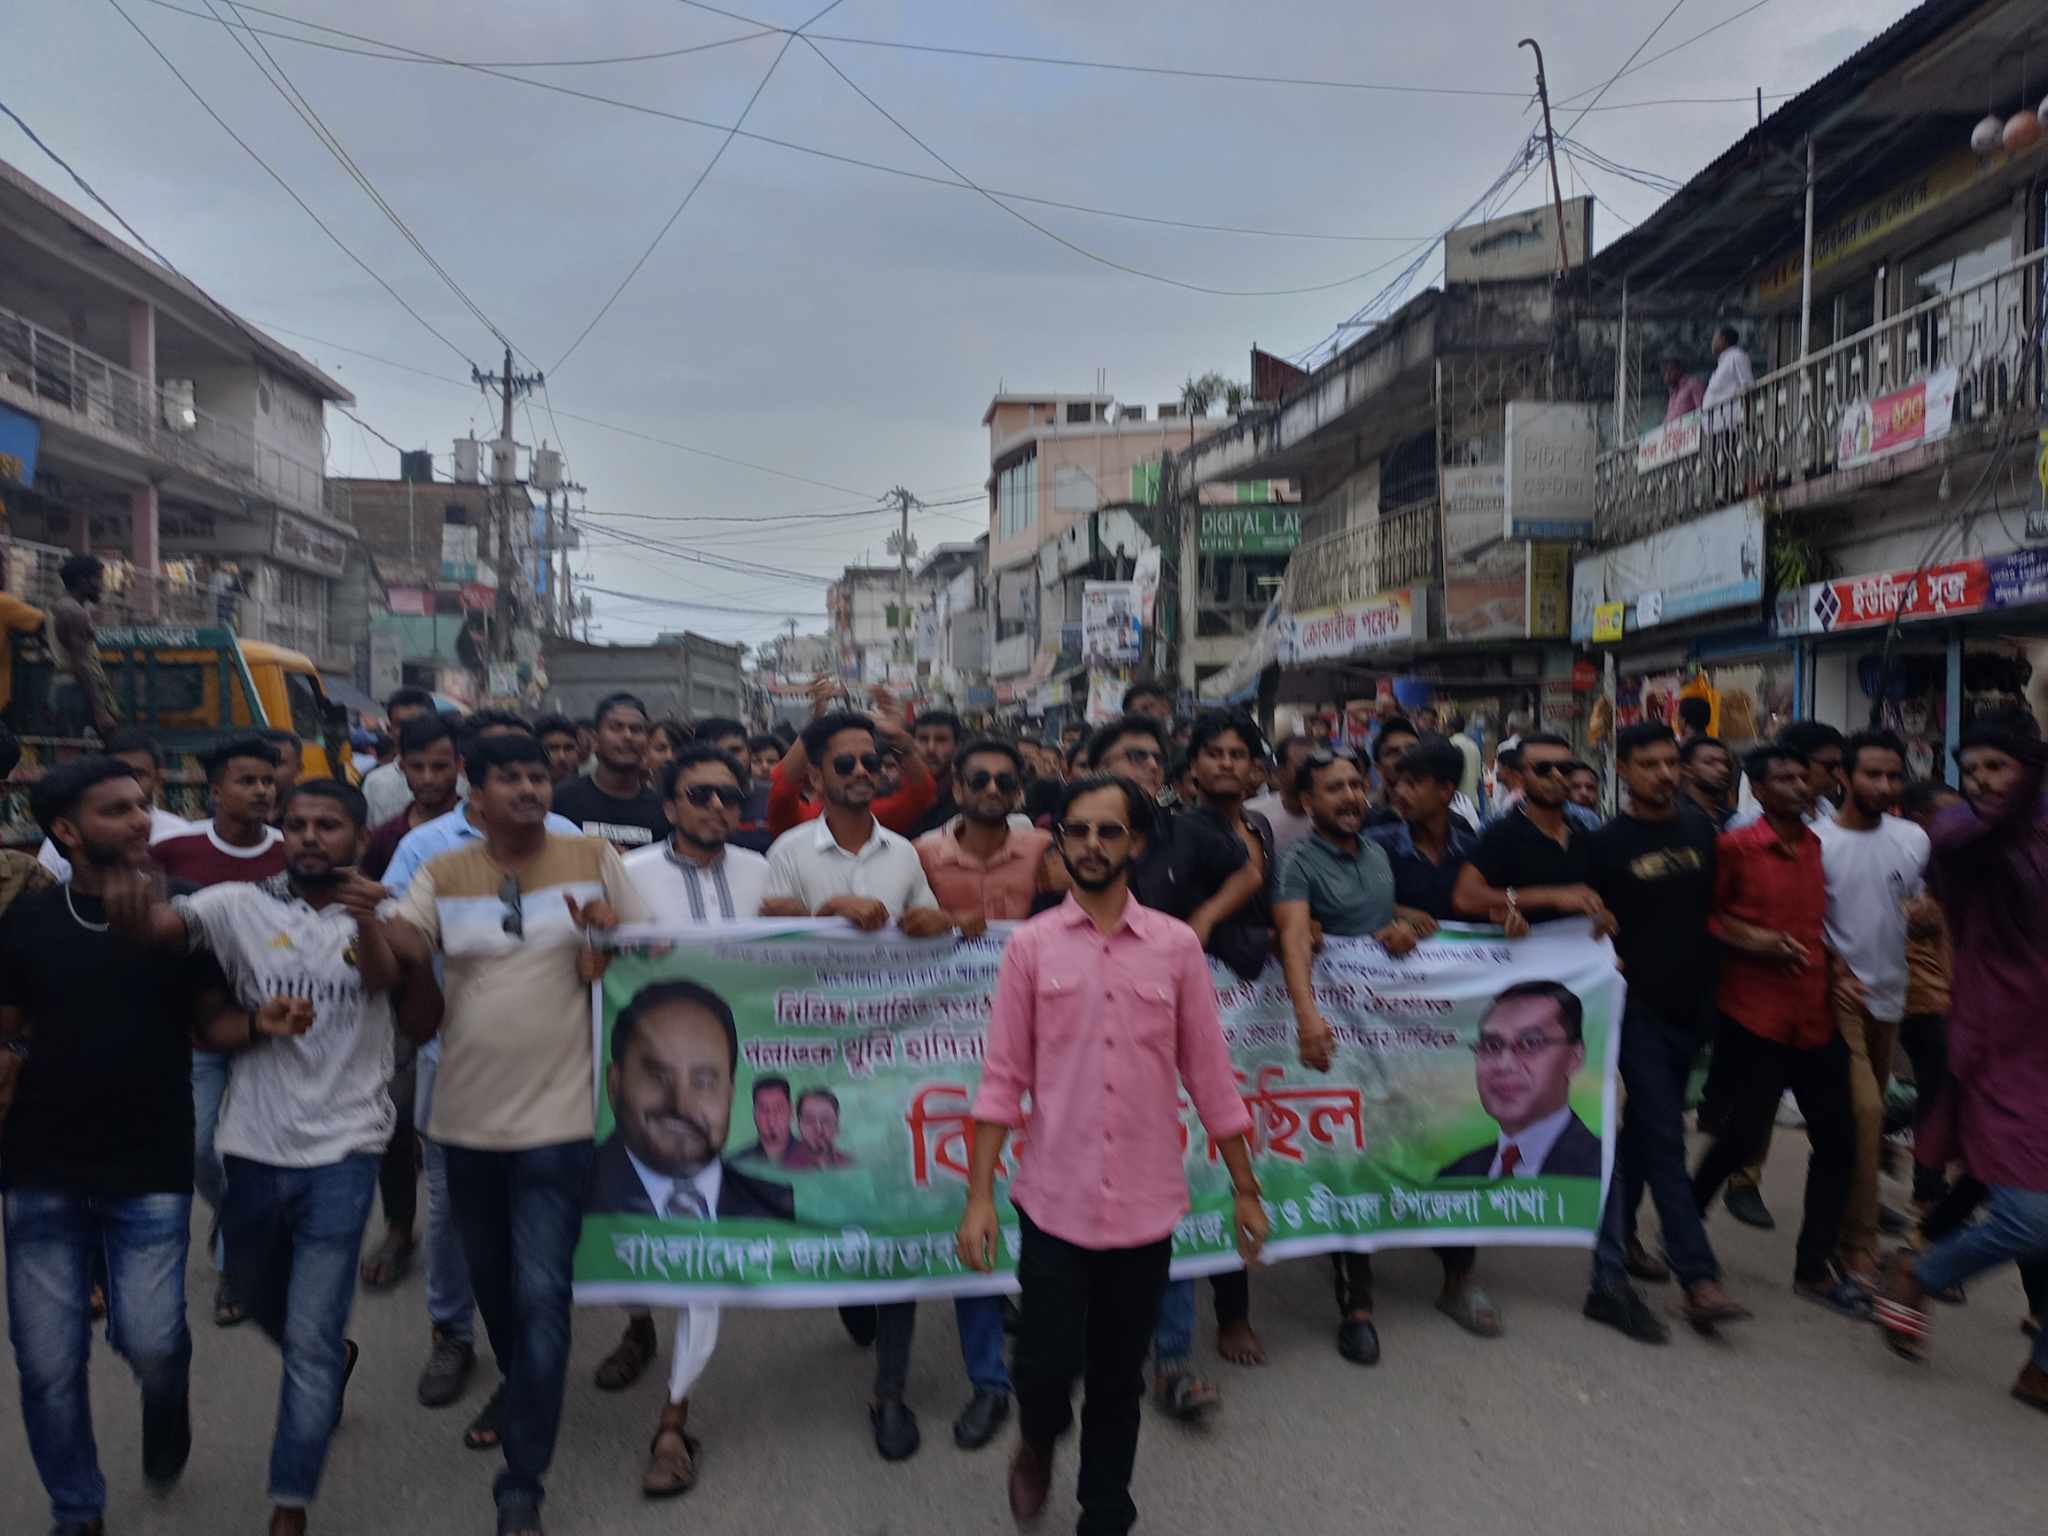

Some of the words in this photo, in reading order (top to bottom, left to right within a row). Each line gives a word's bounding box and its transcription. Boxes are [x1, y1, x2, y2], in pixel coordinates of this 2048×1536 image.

[1201, 510, 1265, 535] DIGITAL
[613, 1231, 774, 1280] বাংলাদেশ
[788, 1226, 964, 1277] জাতীয়তাবা
